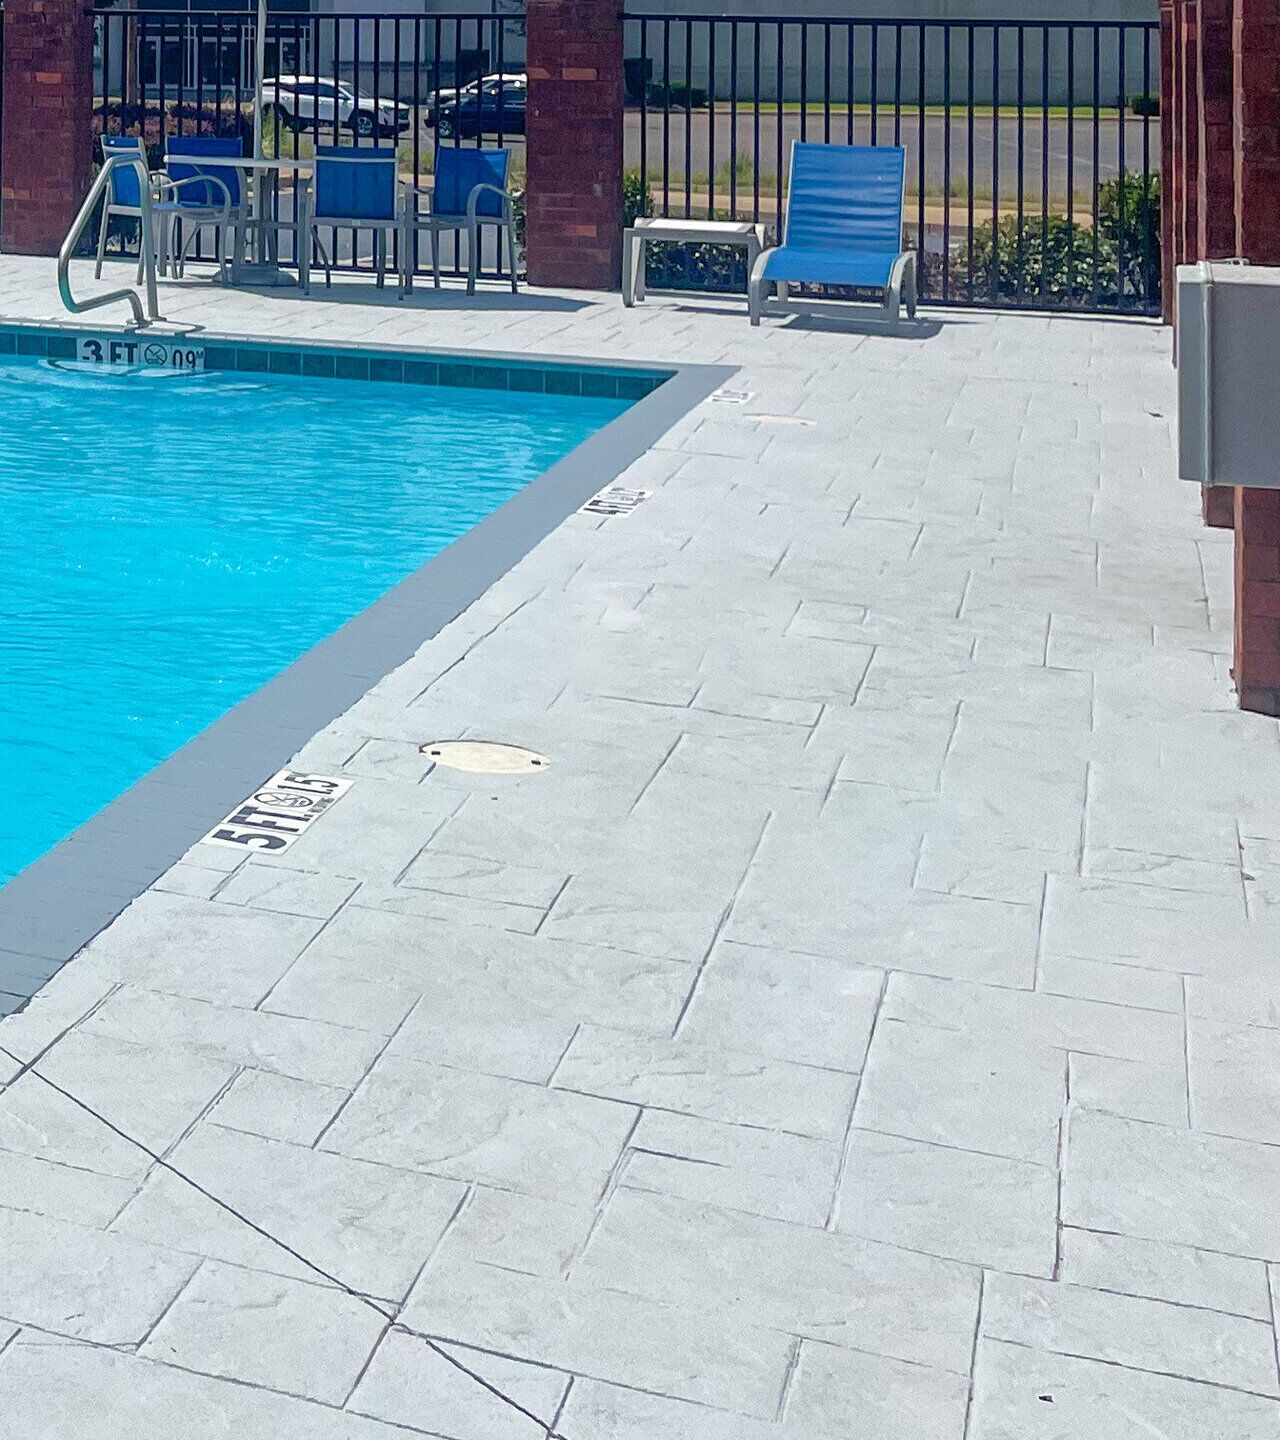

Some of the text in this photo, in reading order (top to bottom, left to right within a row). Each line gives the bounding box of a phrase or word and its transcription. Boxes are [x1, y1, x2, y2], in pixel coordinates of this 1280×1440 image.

[82, 340, 104, 364] 3
[109, 341, 138, 366] FT
[211, 828, 287, 850] 5
